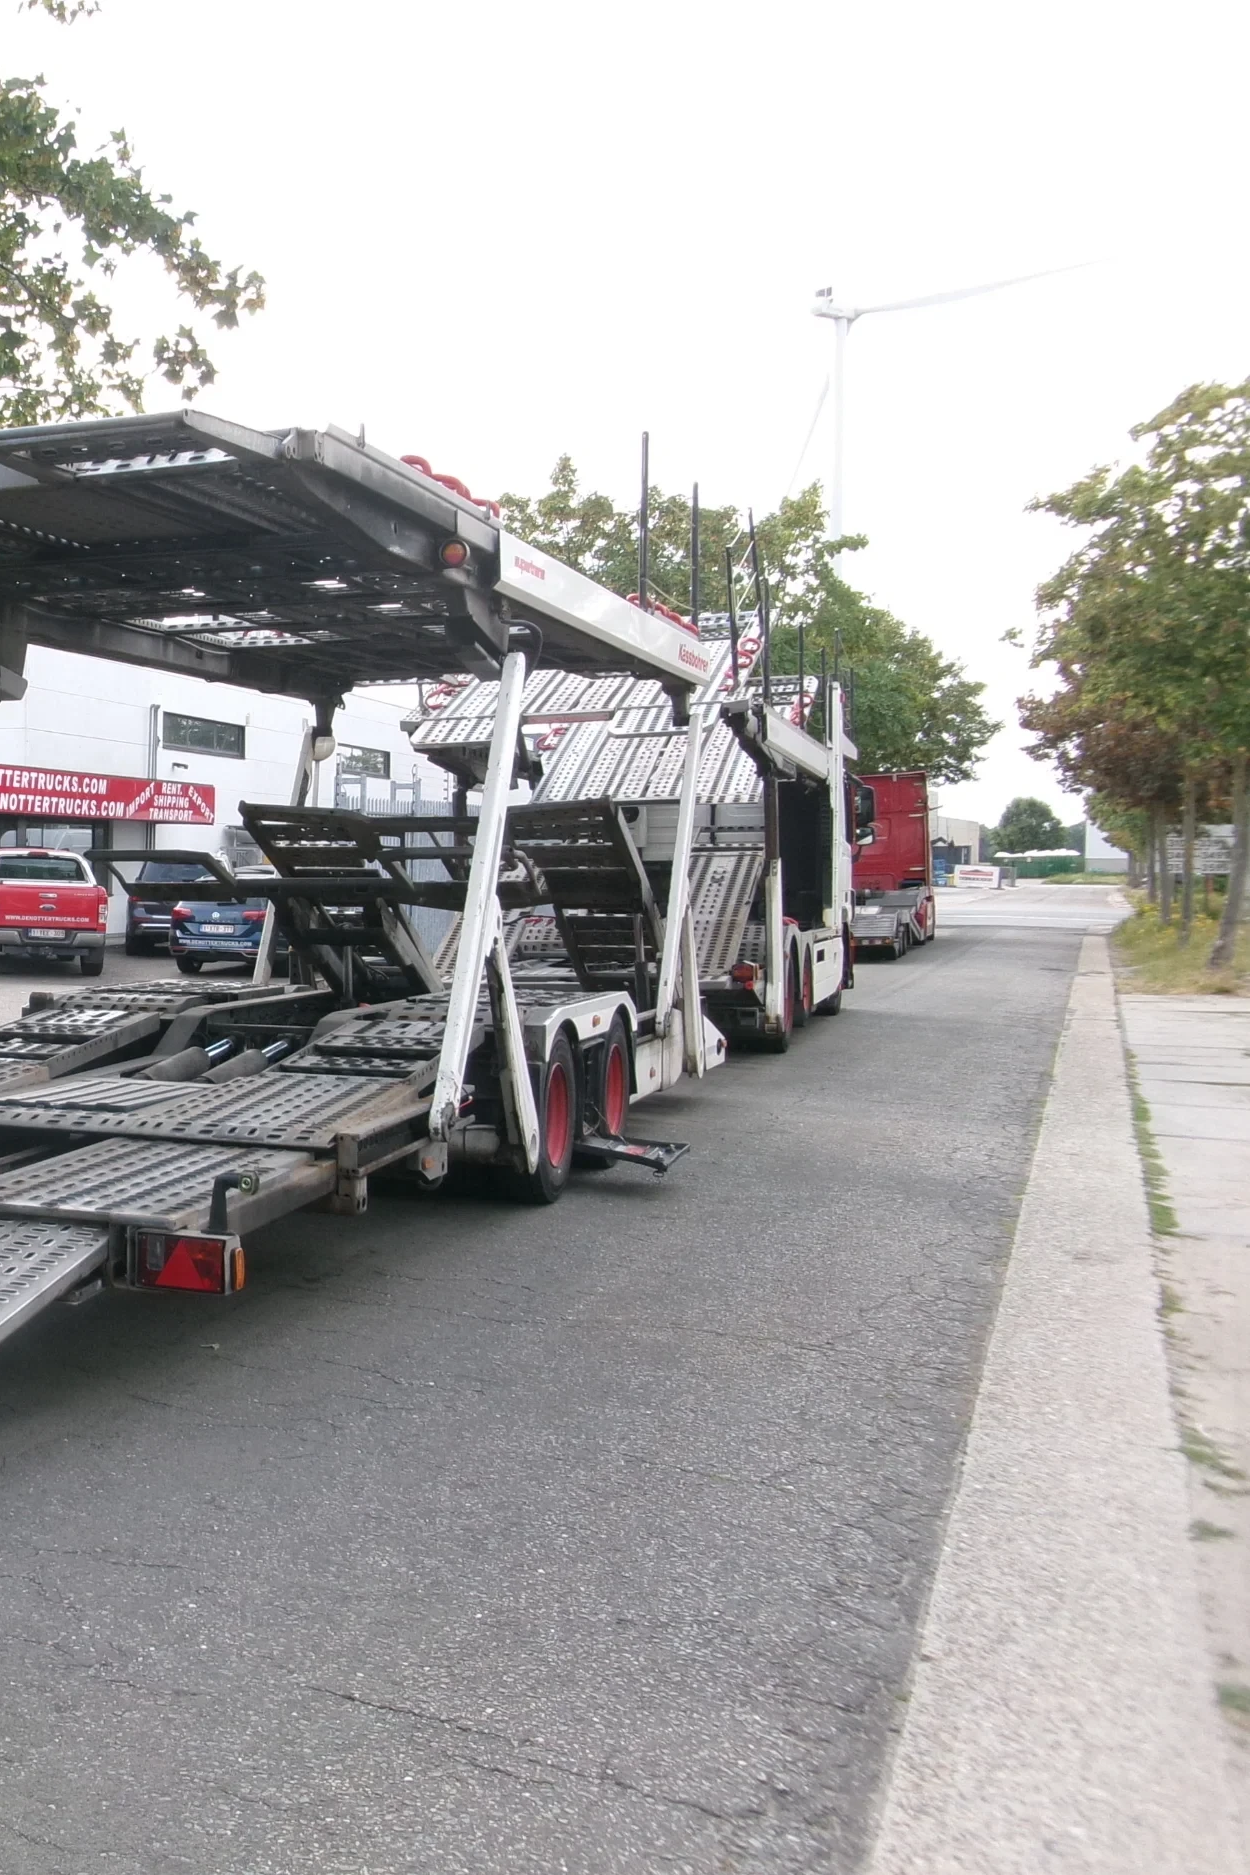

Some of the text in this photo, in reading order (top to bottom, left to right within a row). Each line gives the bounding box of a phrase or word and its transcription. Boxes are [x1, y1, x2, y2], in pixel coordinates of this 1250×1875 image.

[126, 781, 155, 818] IMPORT
[153, 795, 190, 808] SHIPPING
[188, 785, 214, 823] EXPORT
[149, 808, 193, 821] TRANSPORT
[4, 914, 90, 923] WWW.DENOTTERTRUCKS.COM
